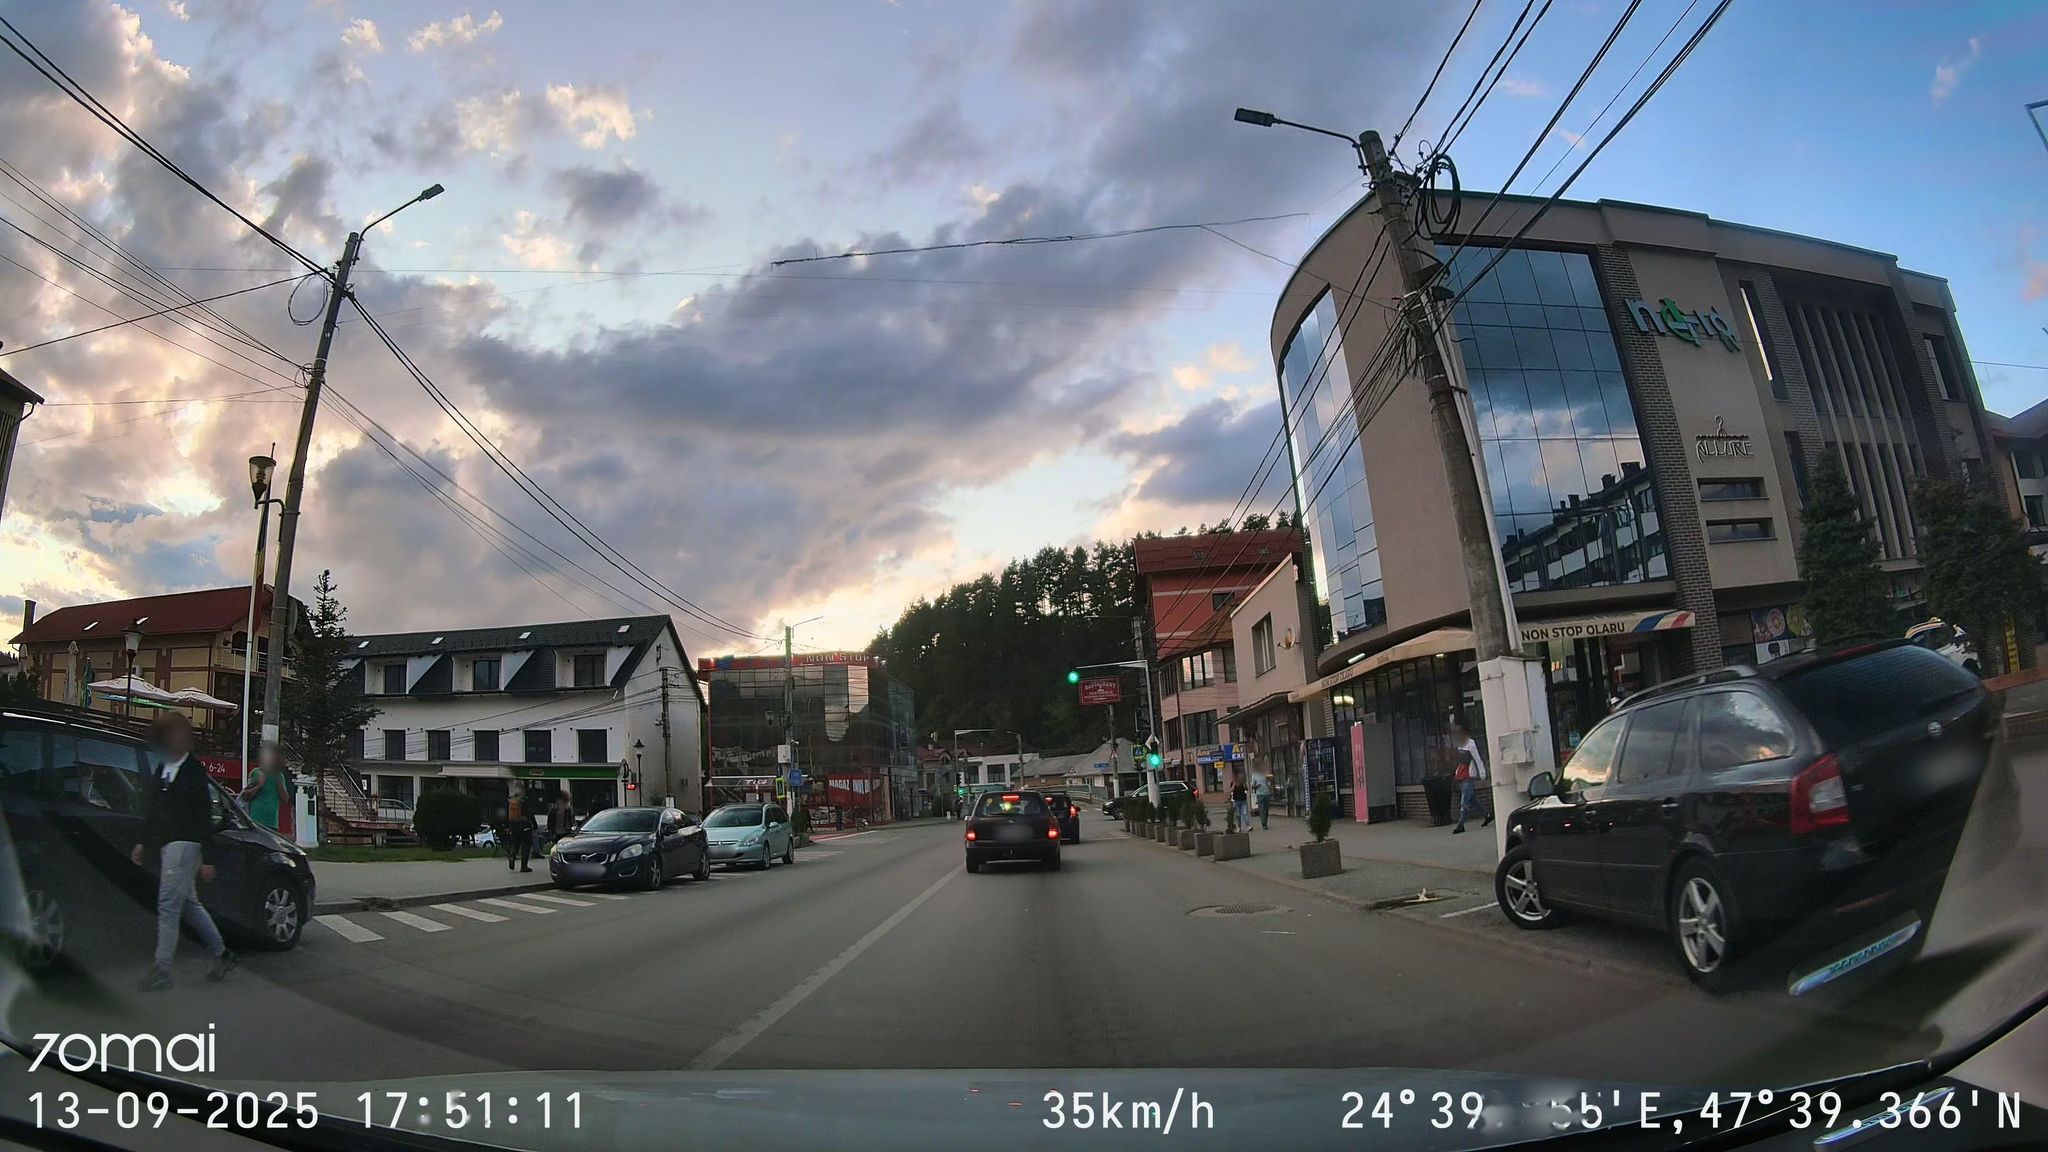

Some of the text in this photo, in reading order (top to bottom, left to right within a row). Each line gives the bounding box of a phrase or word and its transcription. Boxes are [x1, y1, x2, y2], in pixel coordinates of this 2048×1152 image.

[1695, 440, 1754, 464] ALLURE
[1521, 622, 1625, 641] NON STOP OLARU
[209, 762, 226, 773] 6-24
